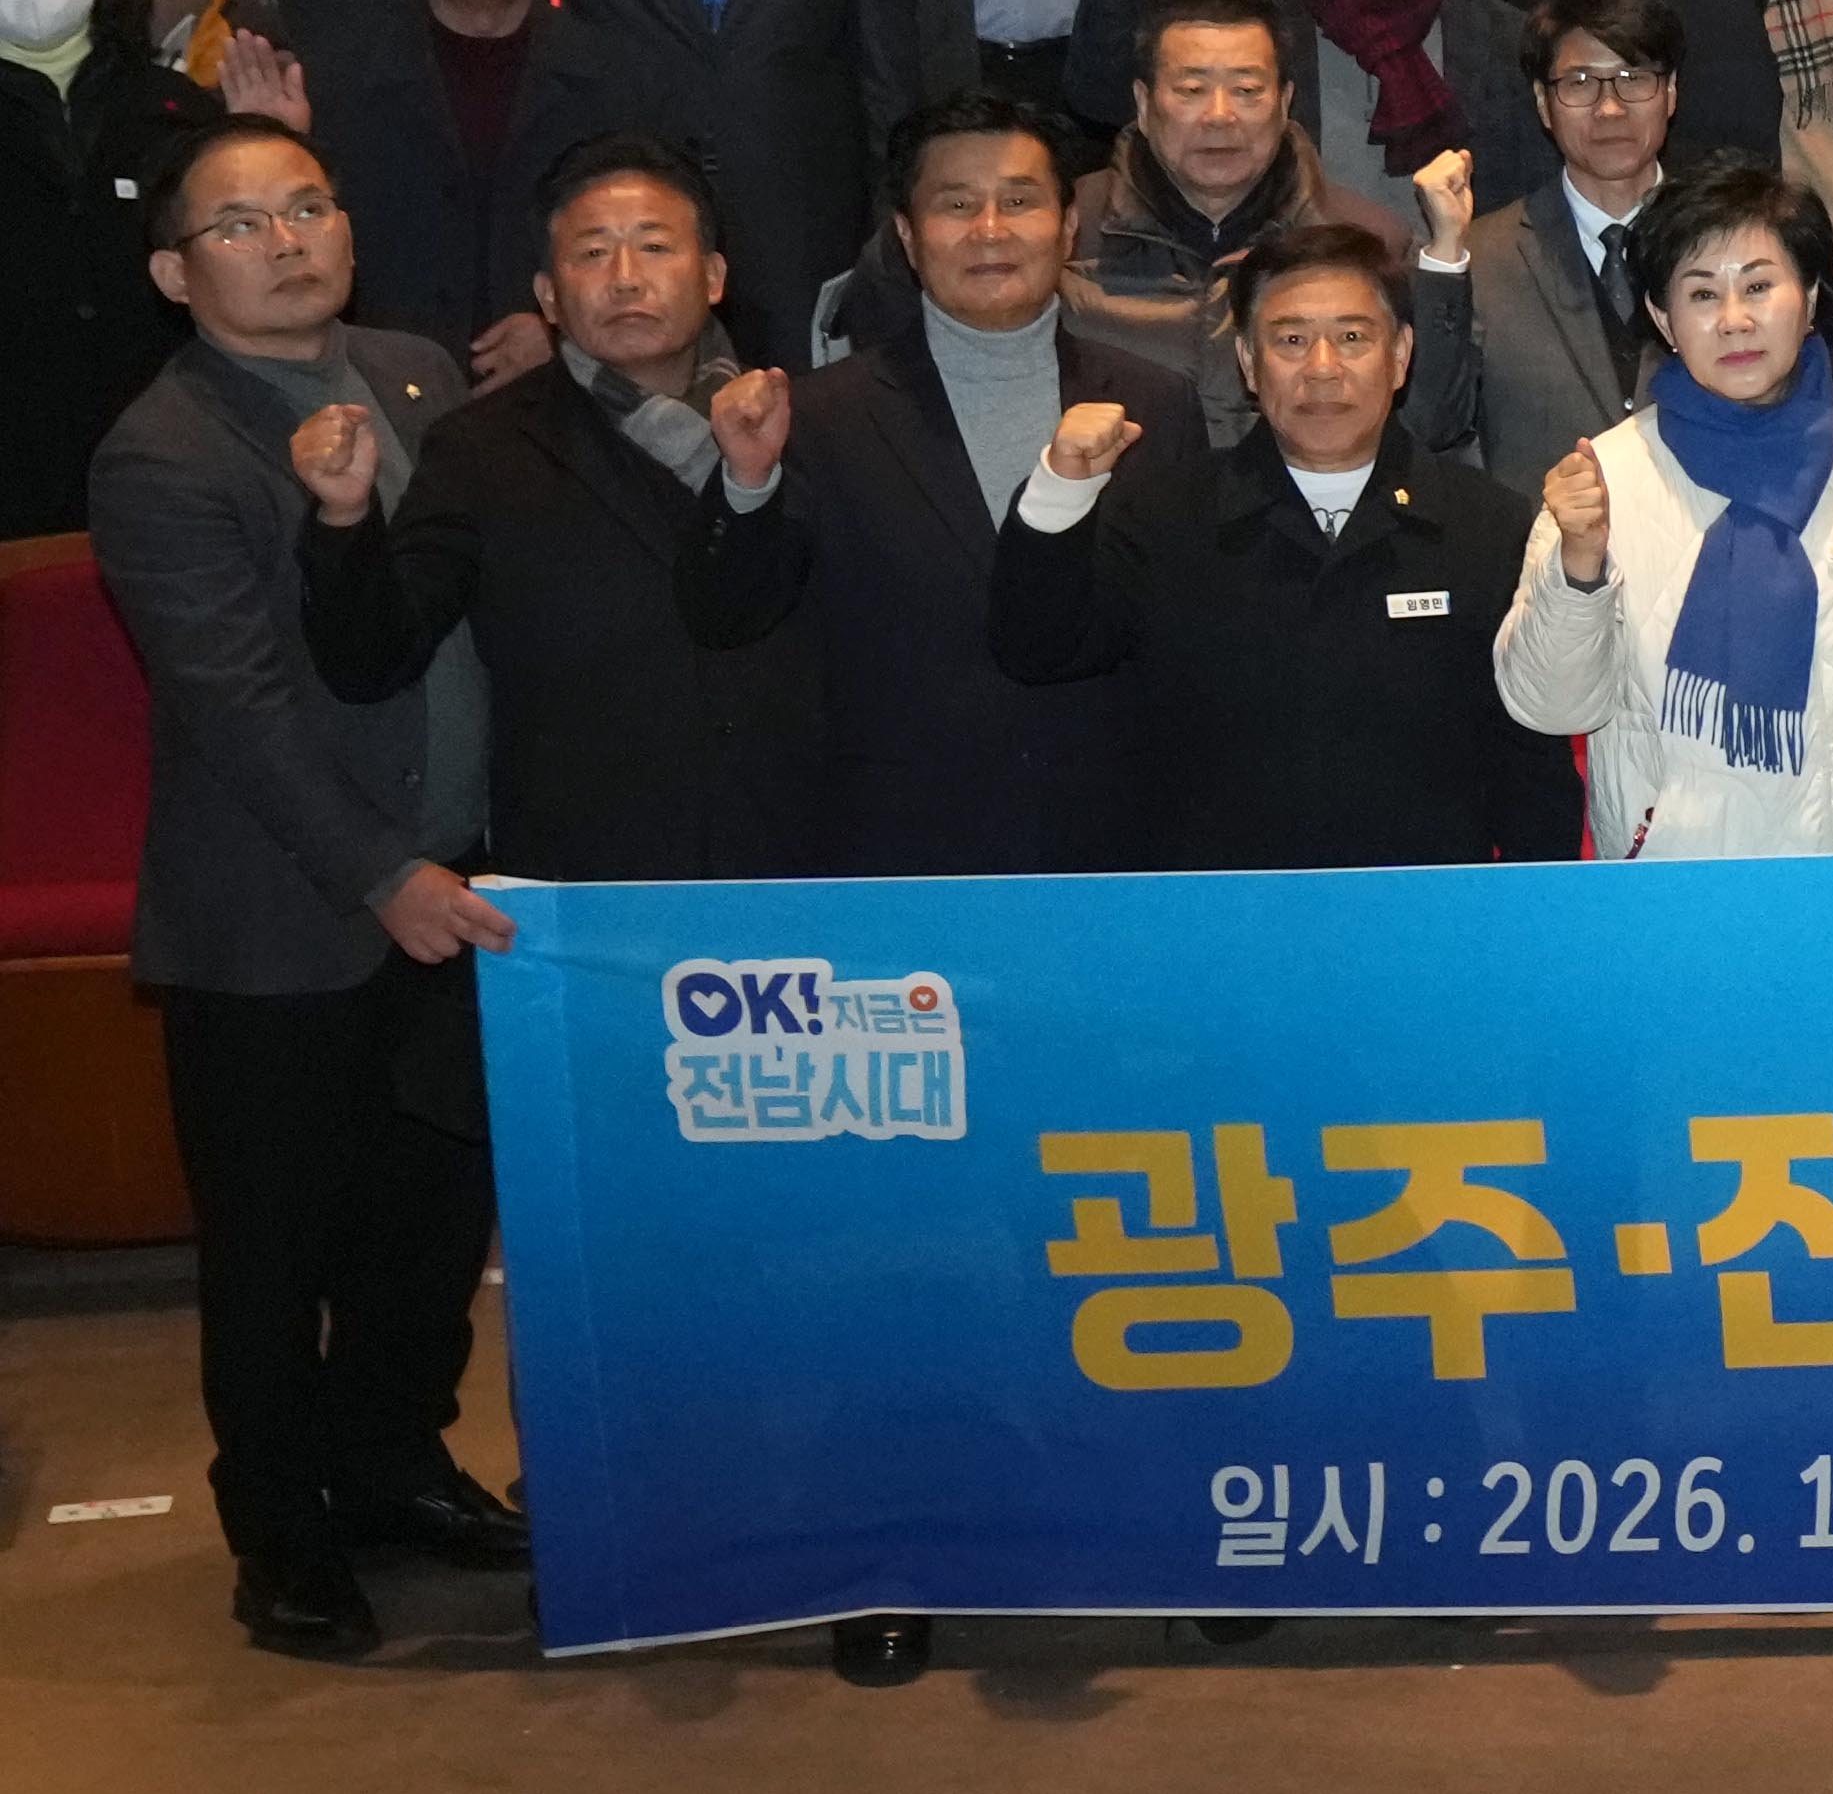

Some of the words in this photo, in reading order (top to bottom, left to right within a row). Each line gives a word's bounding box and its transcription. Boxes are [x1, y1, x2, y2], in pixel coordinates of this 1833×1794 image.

[676, 971, 824, 1037] OK!
[826, 985, 946, 1035] 지금은
[678, 1045, 953, 1127] 전남시대
[1211, 1461, 1385, 1566] 일시
[1480, 1455, 1755, 1555] 2026.
